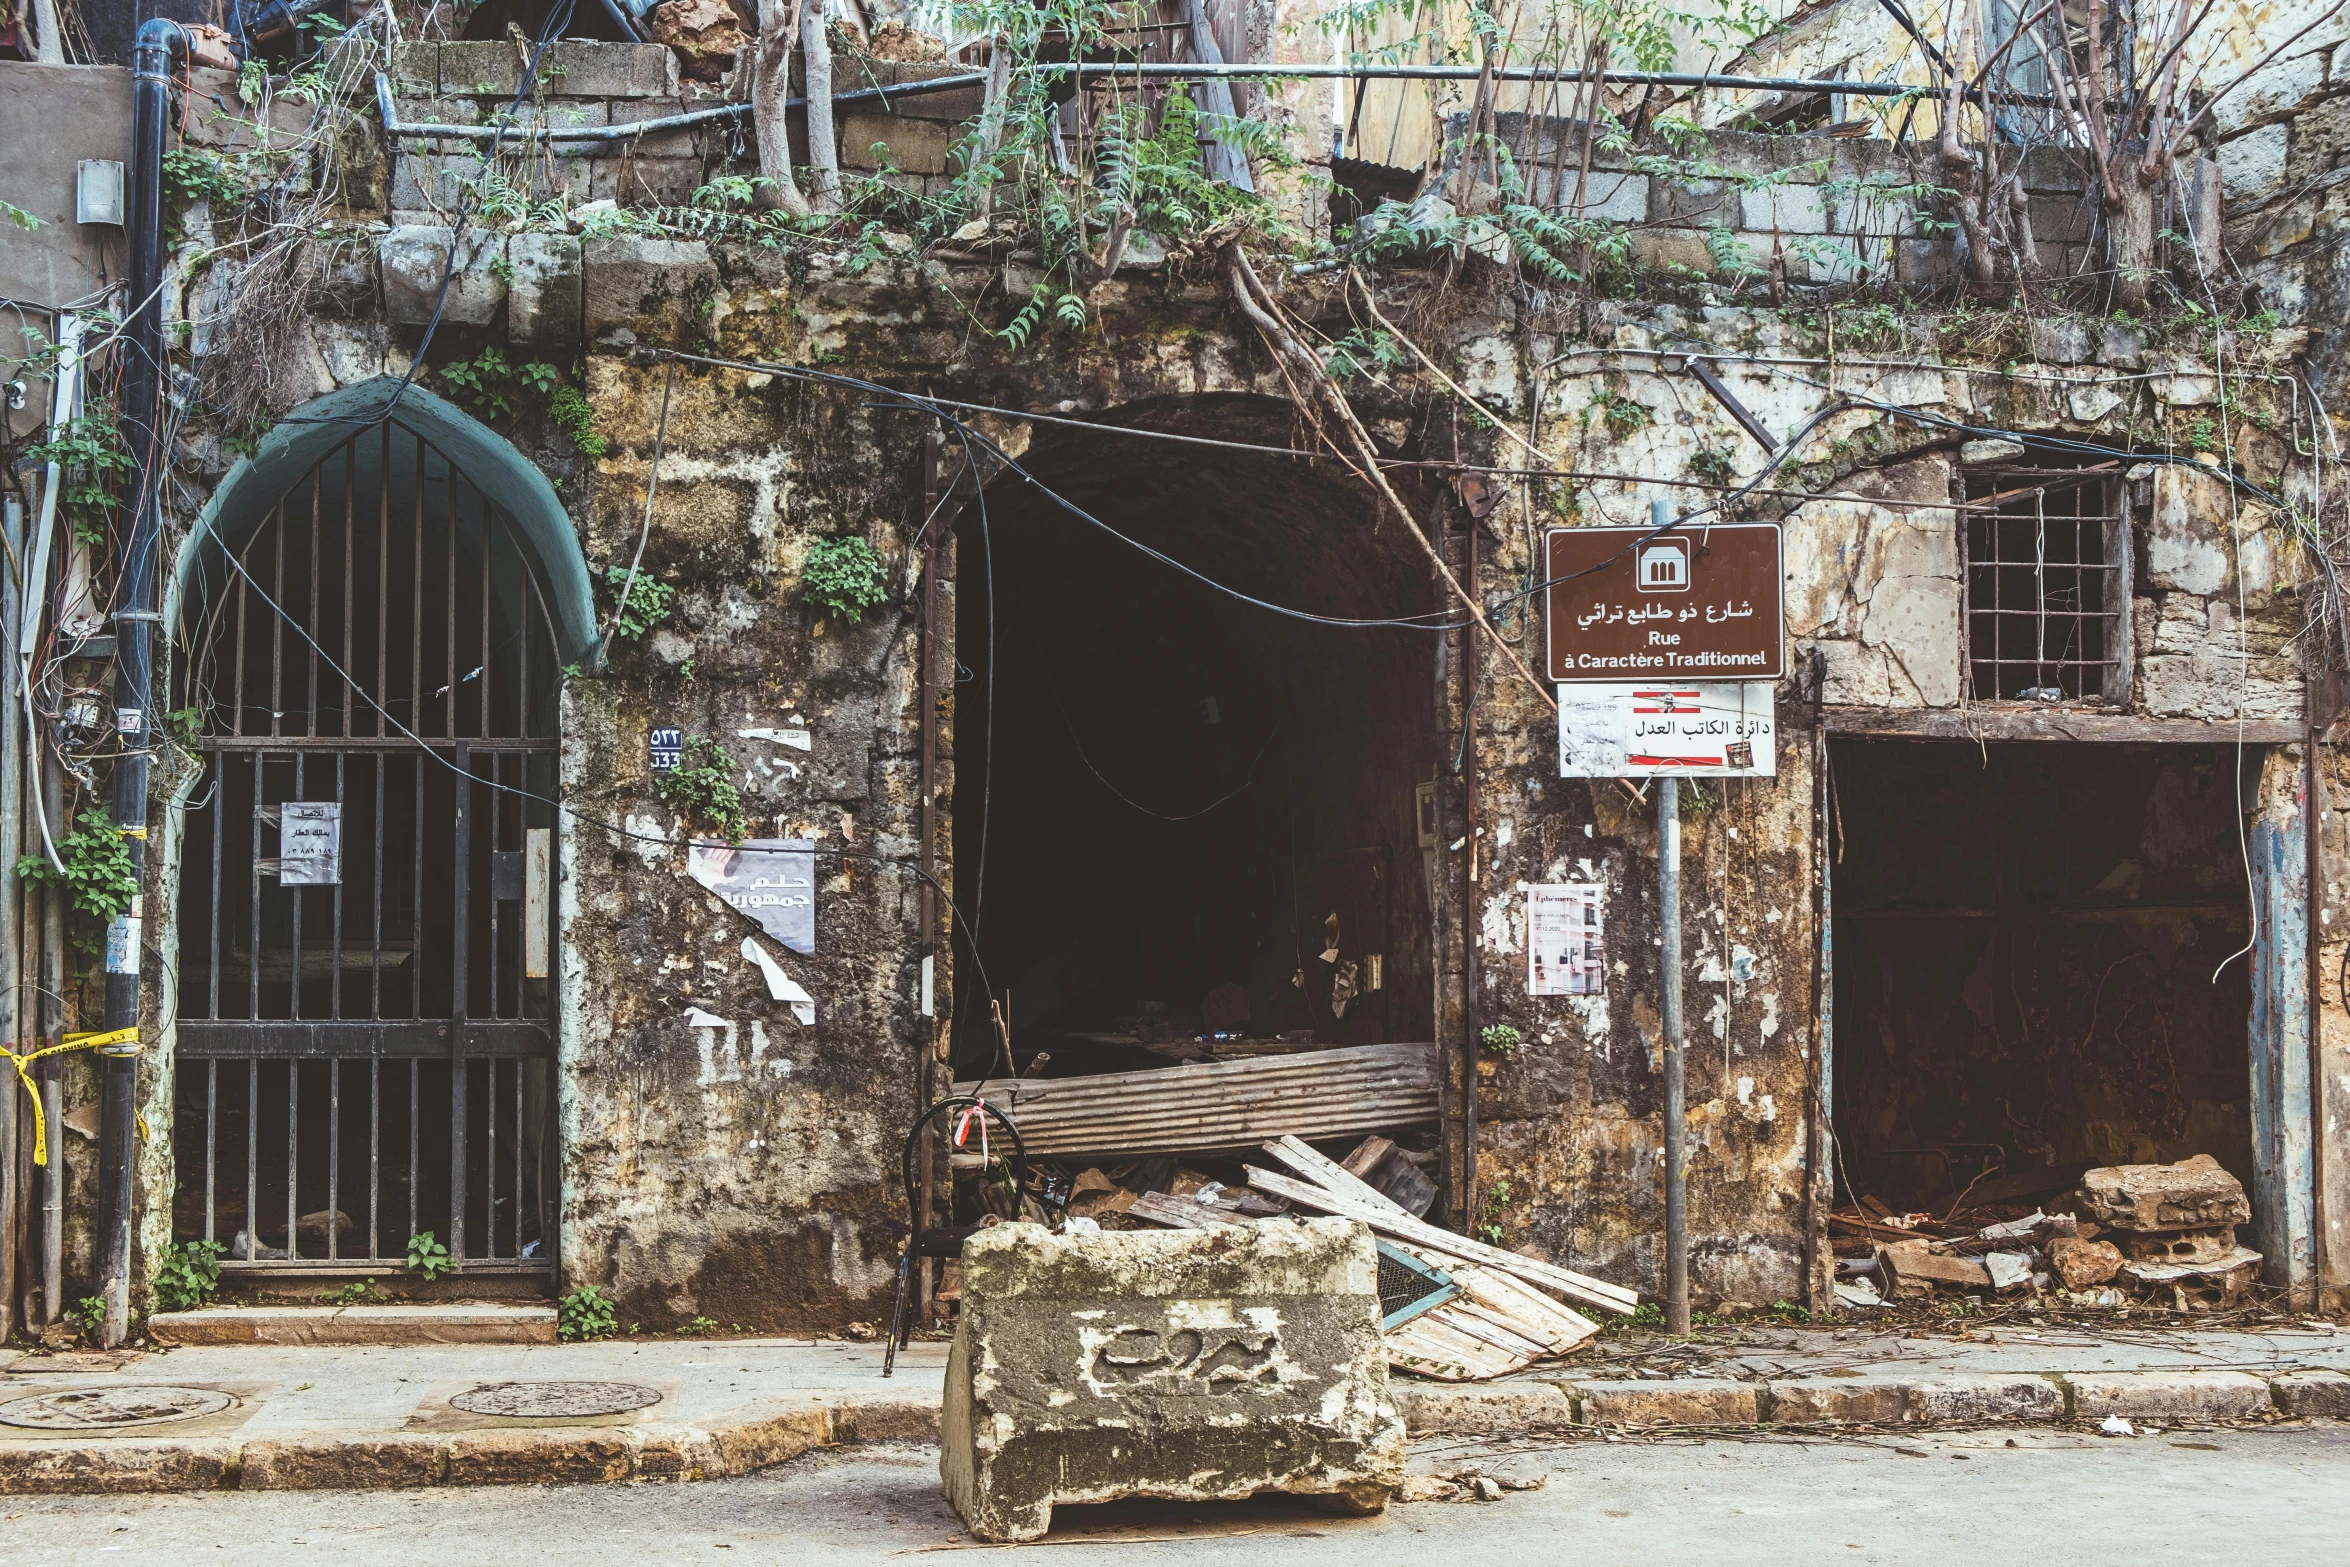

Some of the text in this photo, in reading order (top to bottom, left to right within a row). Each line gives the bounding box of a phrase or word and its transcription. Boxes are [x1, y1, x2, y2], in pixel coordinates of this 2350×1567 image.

[1577, 600, 1753, 631] شارع ذو طابع تراثي
[1648, 631, 1681, 646] Rue
[1565, 650, 1766, 668] à Caractère Traditionnel
[1635, 719, 1770, 740] دائرة الكاتب العدل
[749, 874, 811, 891] حلم
